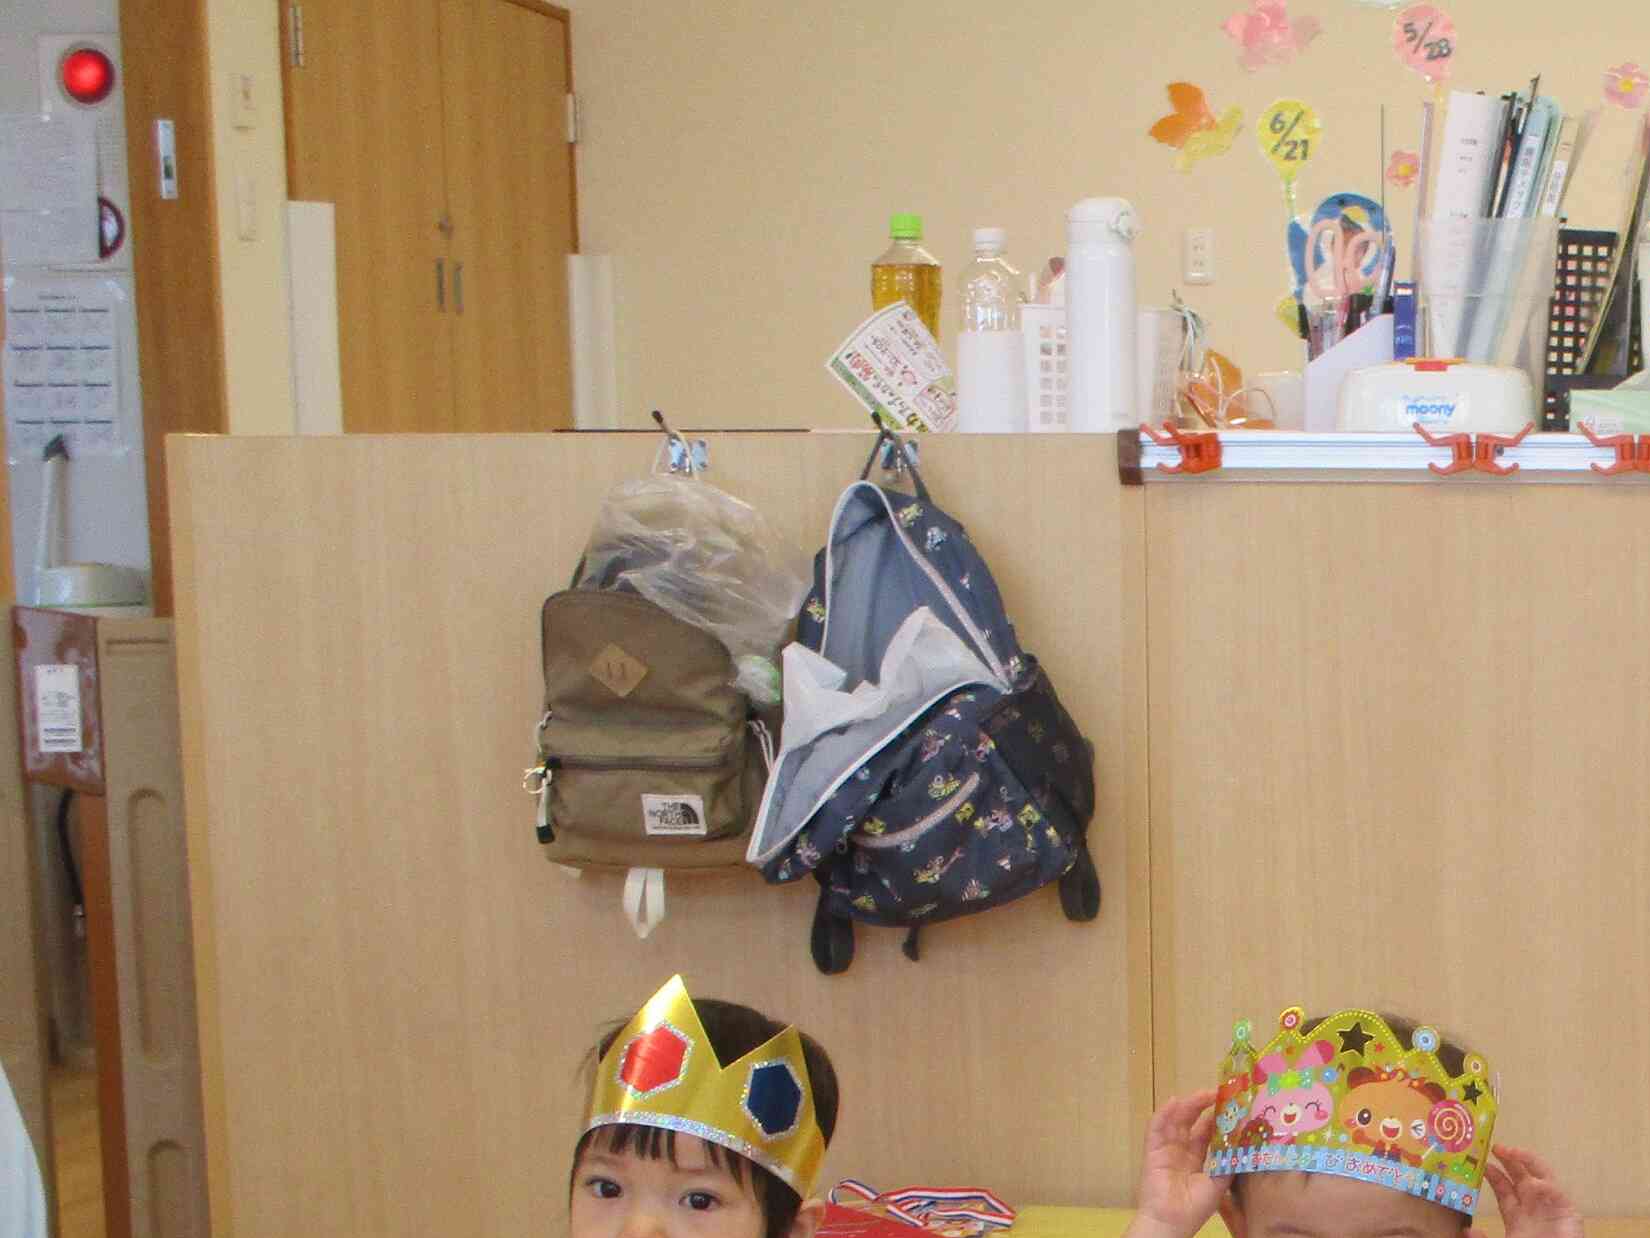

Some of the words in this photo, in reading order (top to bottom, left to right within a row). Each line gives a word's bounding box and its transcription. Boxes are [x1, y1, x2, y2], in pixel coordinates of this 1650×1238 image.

[1403, 21, 1451, 61] 5/28
[1269, 110, 1310, 161] 6/21
[1406, 402, 1455, 416] moony
